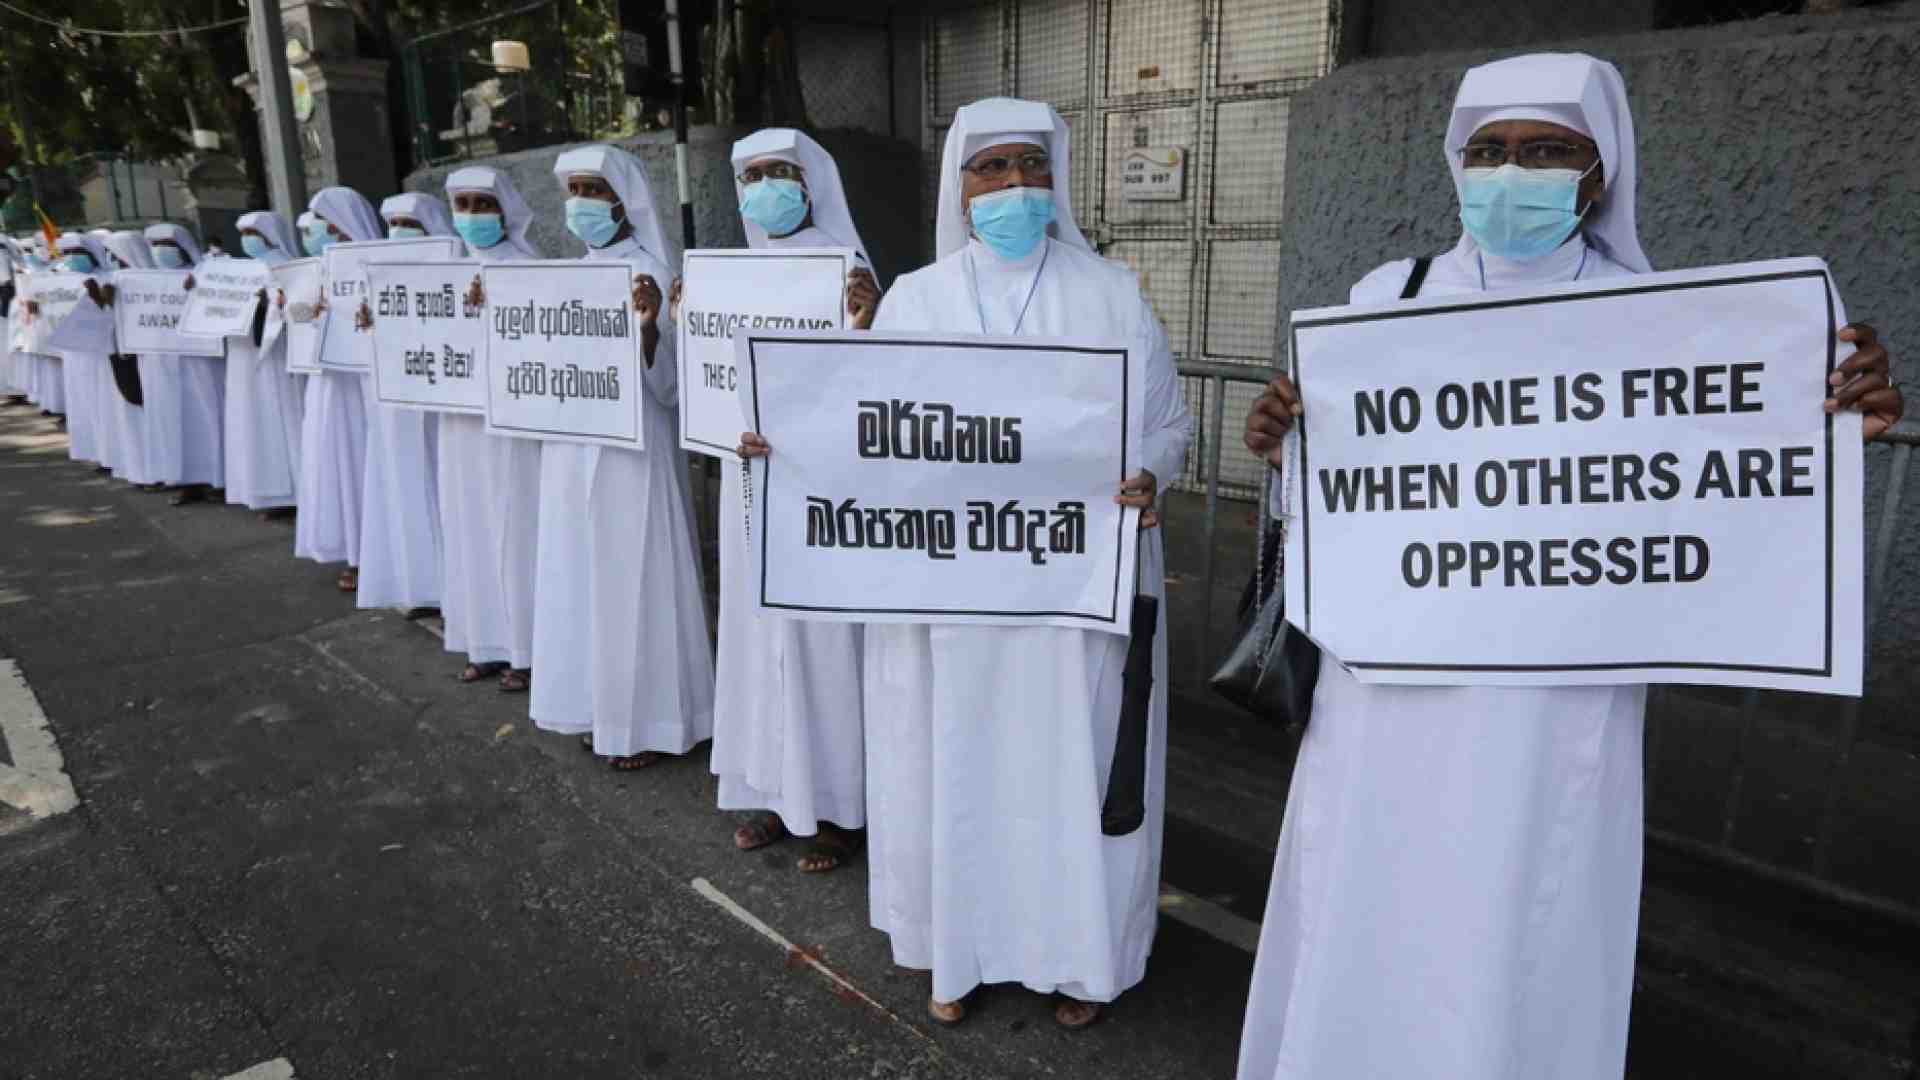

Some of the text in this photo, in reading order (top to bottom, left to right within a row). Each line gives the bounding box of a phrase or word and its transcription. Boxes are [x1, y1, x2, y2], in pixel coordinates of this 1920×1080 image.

[333, 280, 355, 296] LET
[703, 363, 726, 390] THE
[1354, 361, 1765, 437] NO ONE IS FREE
[857, 398, 1023, 465] මර්ධනය
[1318, 446, 1815, 513] WHEN OTHERS ARE
[806, 495, 1086, 566] බරපතල වරදකි
[1401, 534, 1710, 589] OPPRESSED
